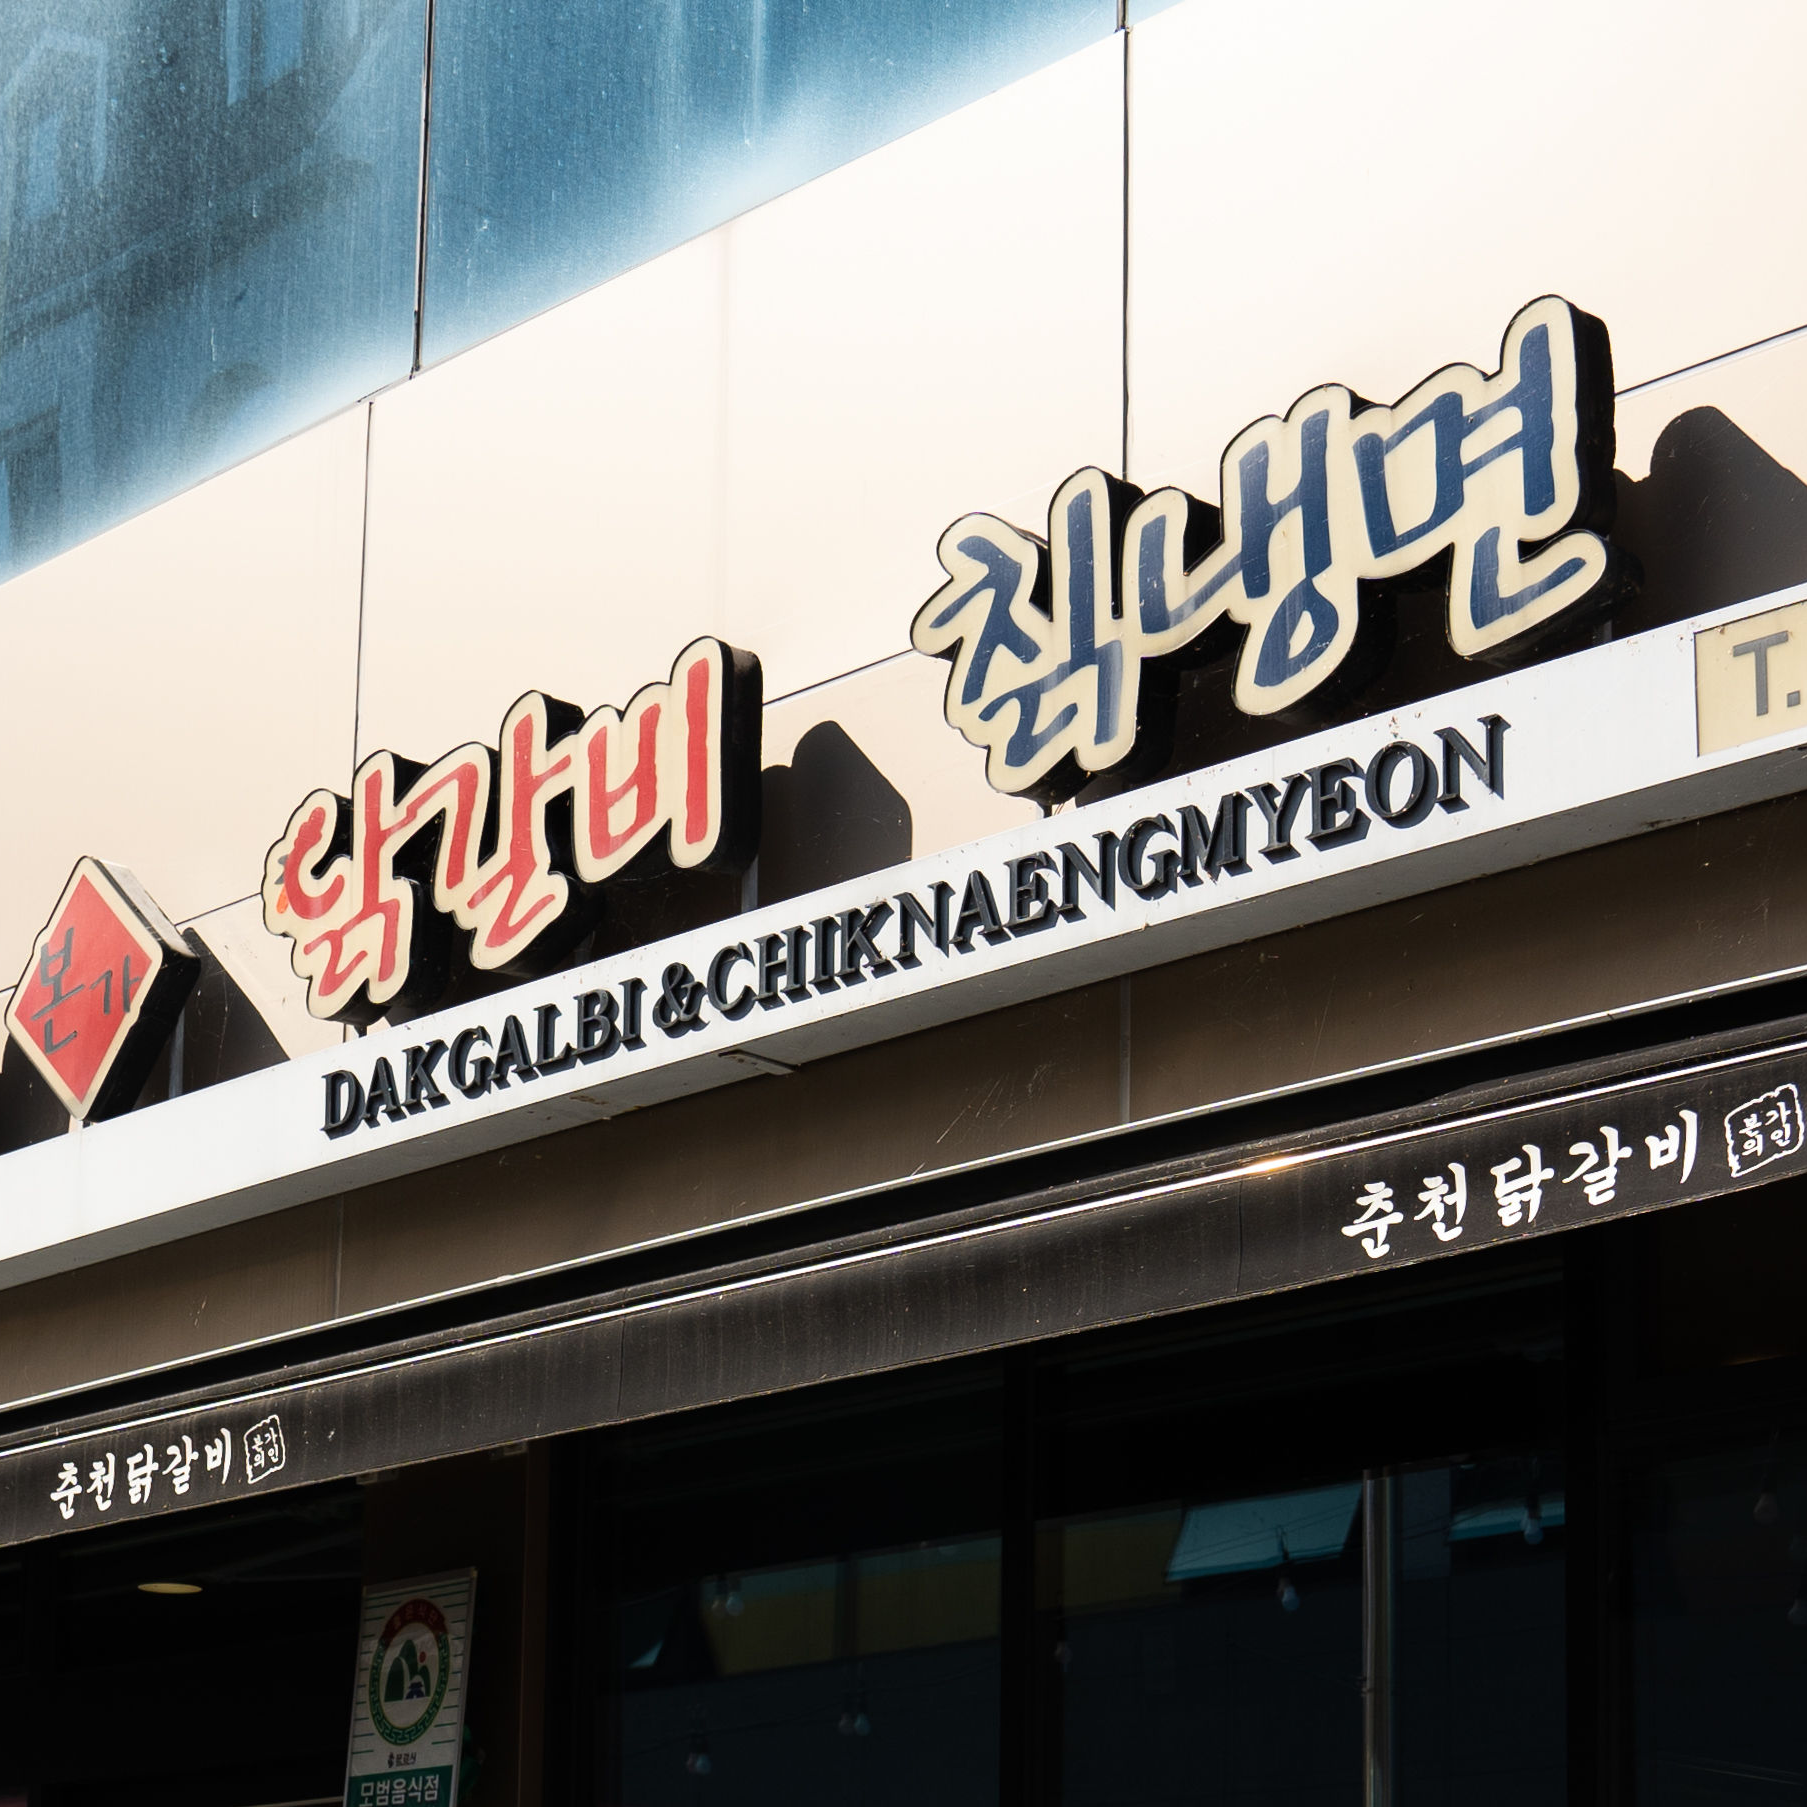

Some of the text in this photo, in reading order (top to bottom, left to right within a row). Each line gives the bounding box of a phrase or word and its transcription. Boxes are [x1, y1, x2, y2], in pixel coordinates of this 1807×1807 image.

[911, 294, 1607, 795] 칡냉면
[262, 636, 724, 1020] 닭갈비
[31, 927, 143, 1056] 본가
[1341, 1110, 1699, 1260] 춘천닭갈비
[49, 1427, 234, 1520] 춘천닭갈비
[359, 1775, 439, 1807] 모범음식점
